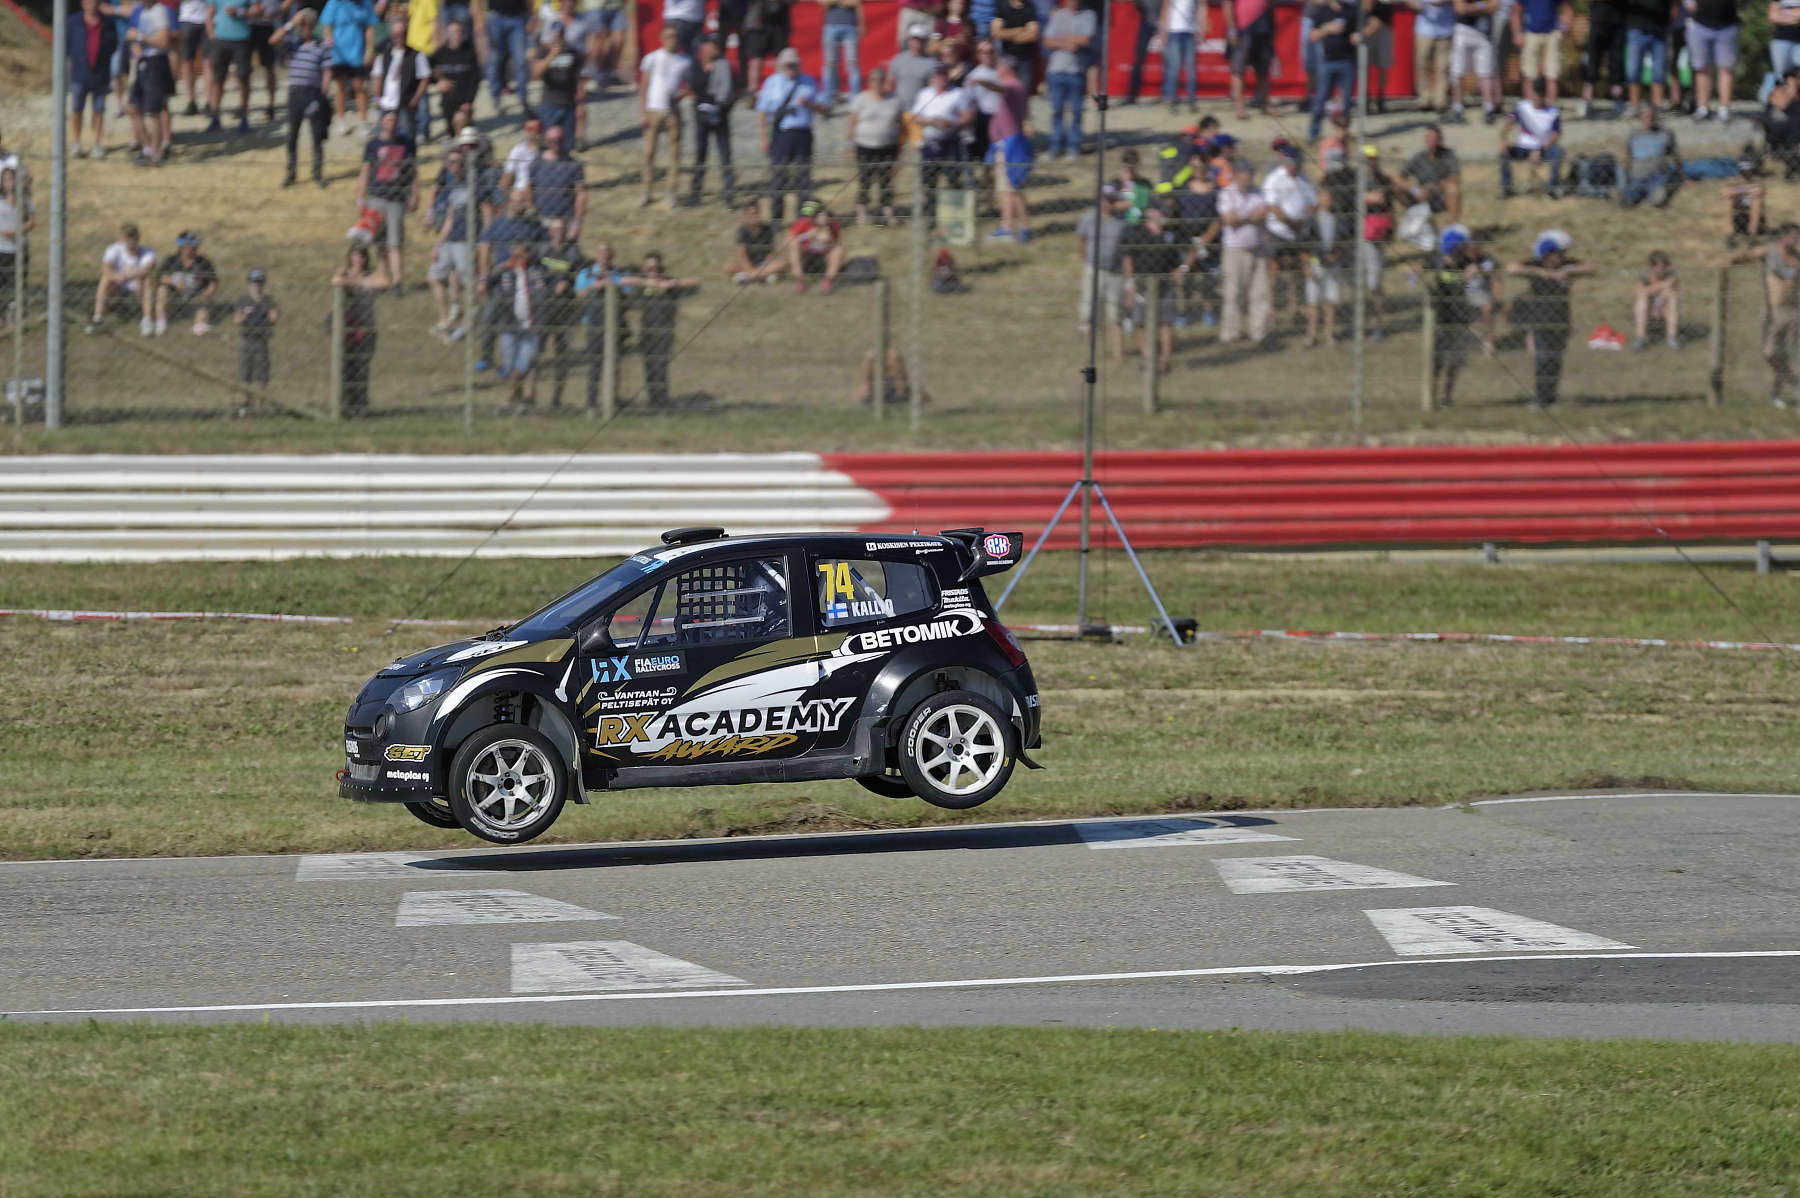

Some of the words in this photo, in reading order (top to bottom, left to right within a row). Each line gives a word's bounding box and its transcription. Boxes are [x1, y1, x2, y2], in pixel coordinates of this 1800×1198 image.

[818, 562, 855, 602] 74
[859, 619, 964, 650] BETOMIK
[635, 663, 681, 673] RALLYCROSS
[601, 697, 660, 710] PELTISEPÄT
[660, 697, 674, 705] OY
[614, 690, 660, 700] VANTAAN
[598, 713, 655, 746] RX
[656, 698, 851, 740] ACADEMY
[907, 706, 932, 758] COOPER
[648, 732, 800, 761] AWARD
